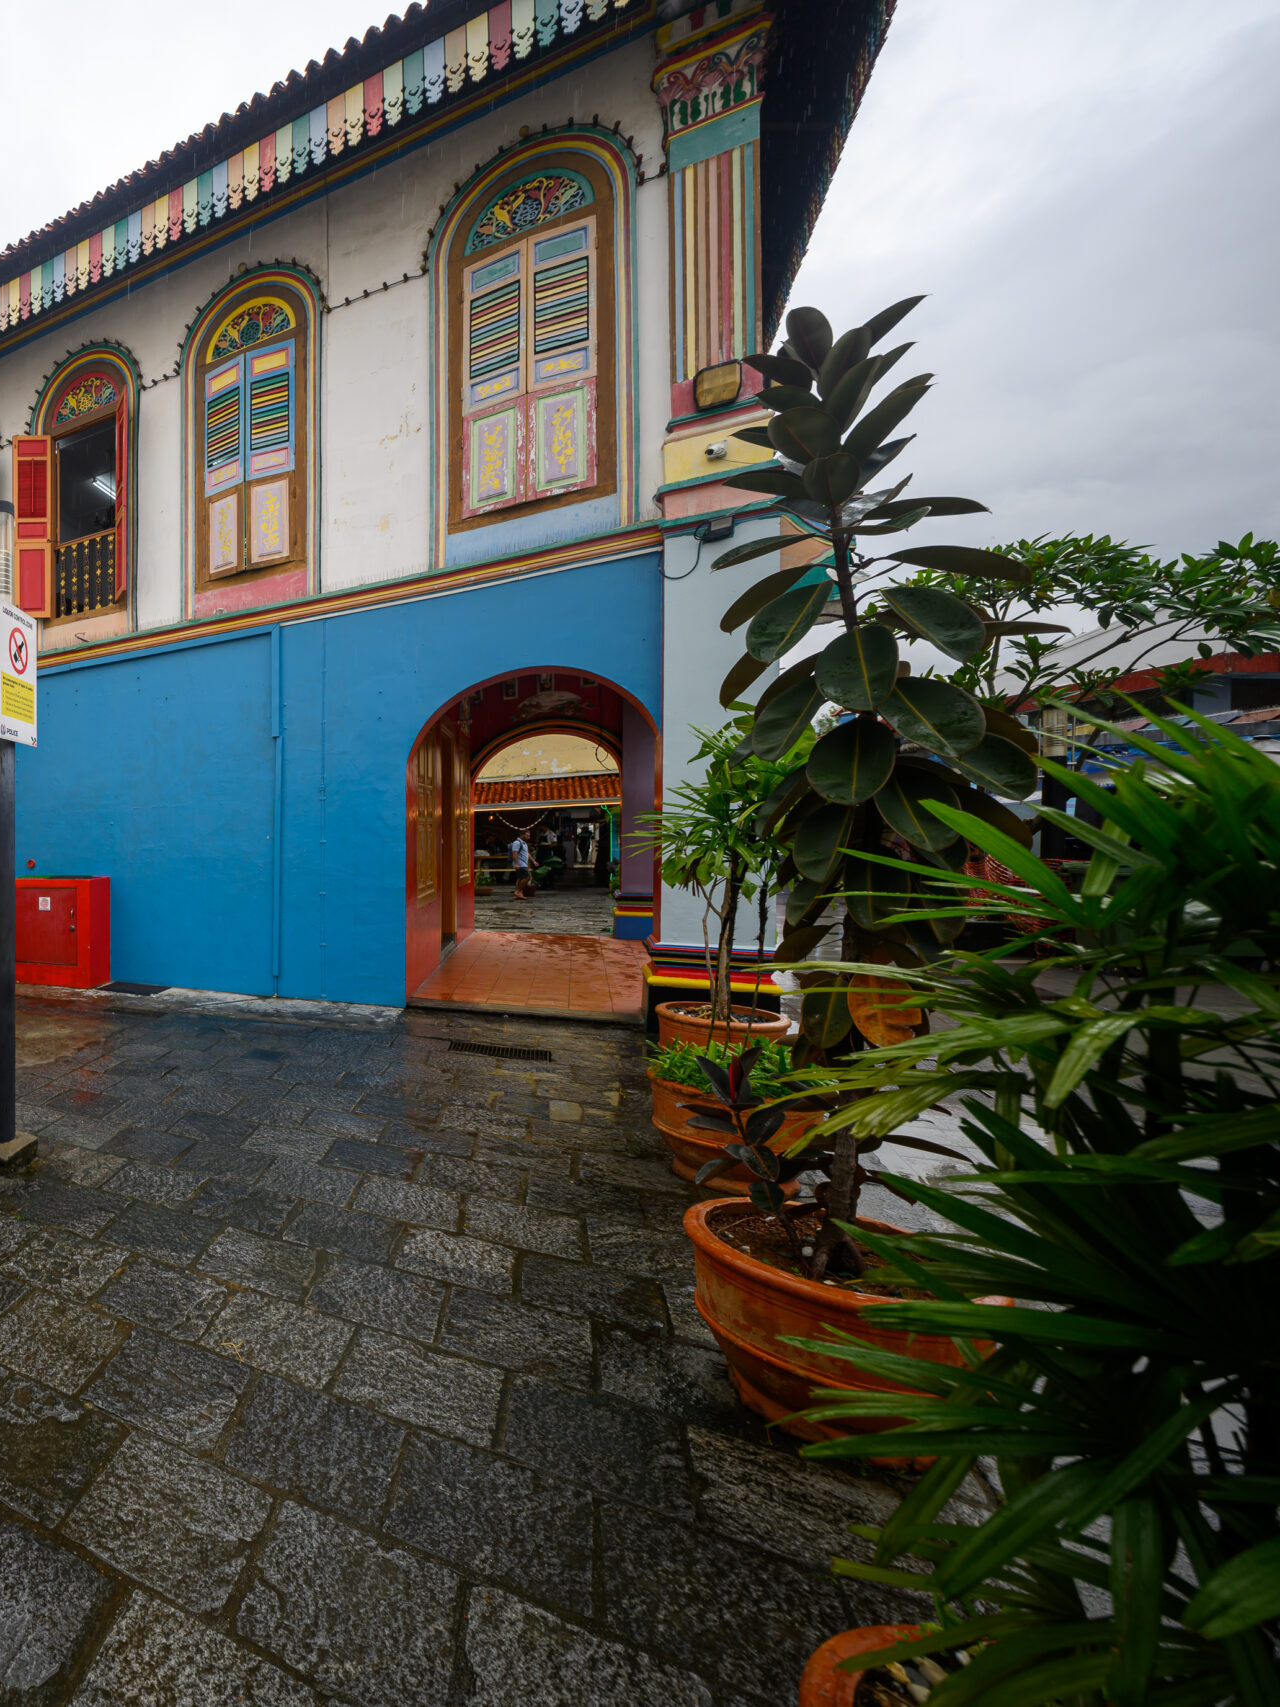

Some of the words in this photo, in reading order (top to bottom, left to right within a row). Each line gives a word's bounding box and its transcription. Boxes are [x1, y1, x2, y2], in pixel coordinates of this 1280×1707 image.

[2, 605, 13, 617] LIQUOR
[13, 613, 26, 626] CONTROL
[6, 728, 18, 736] POLICE
